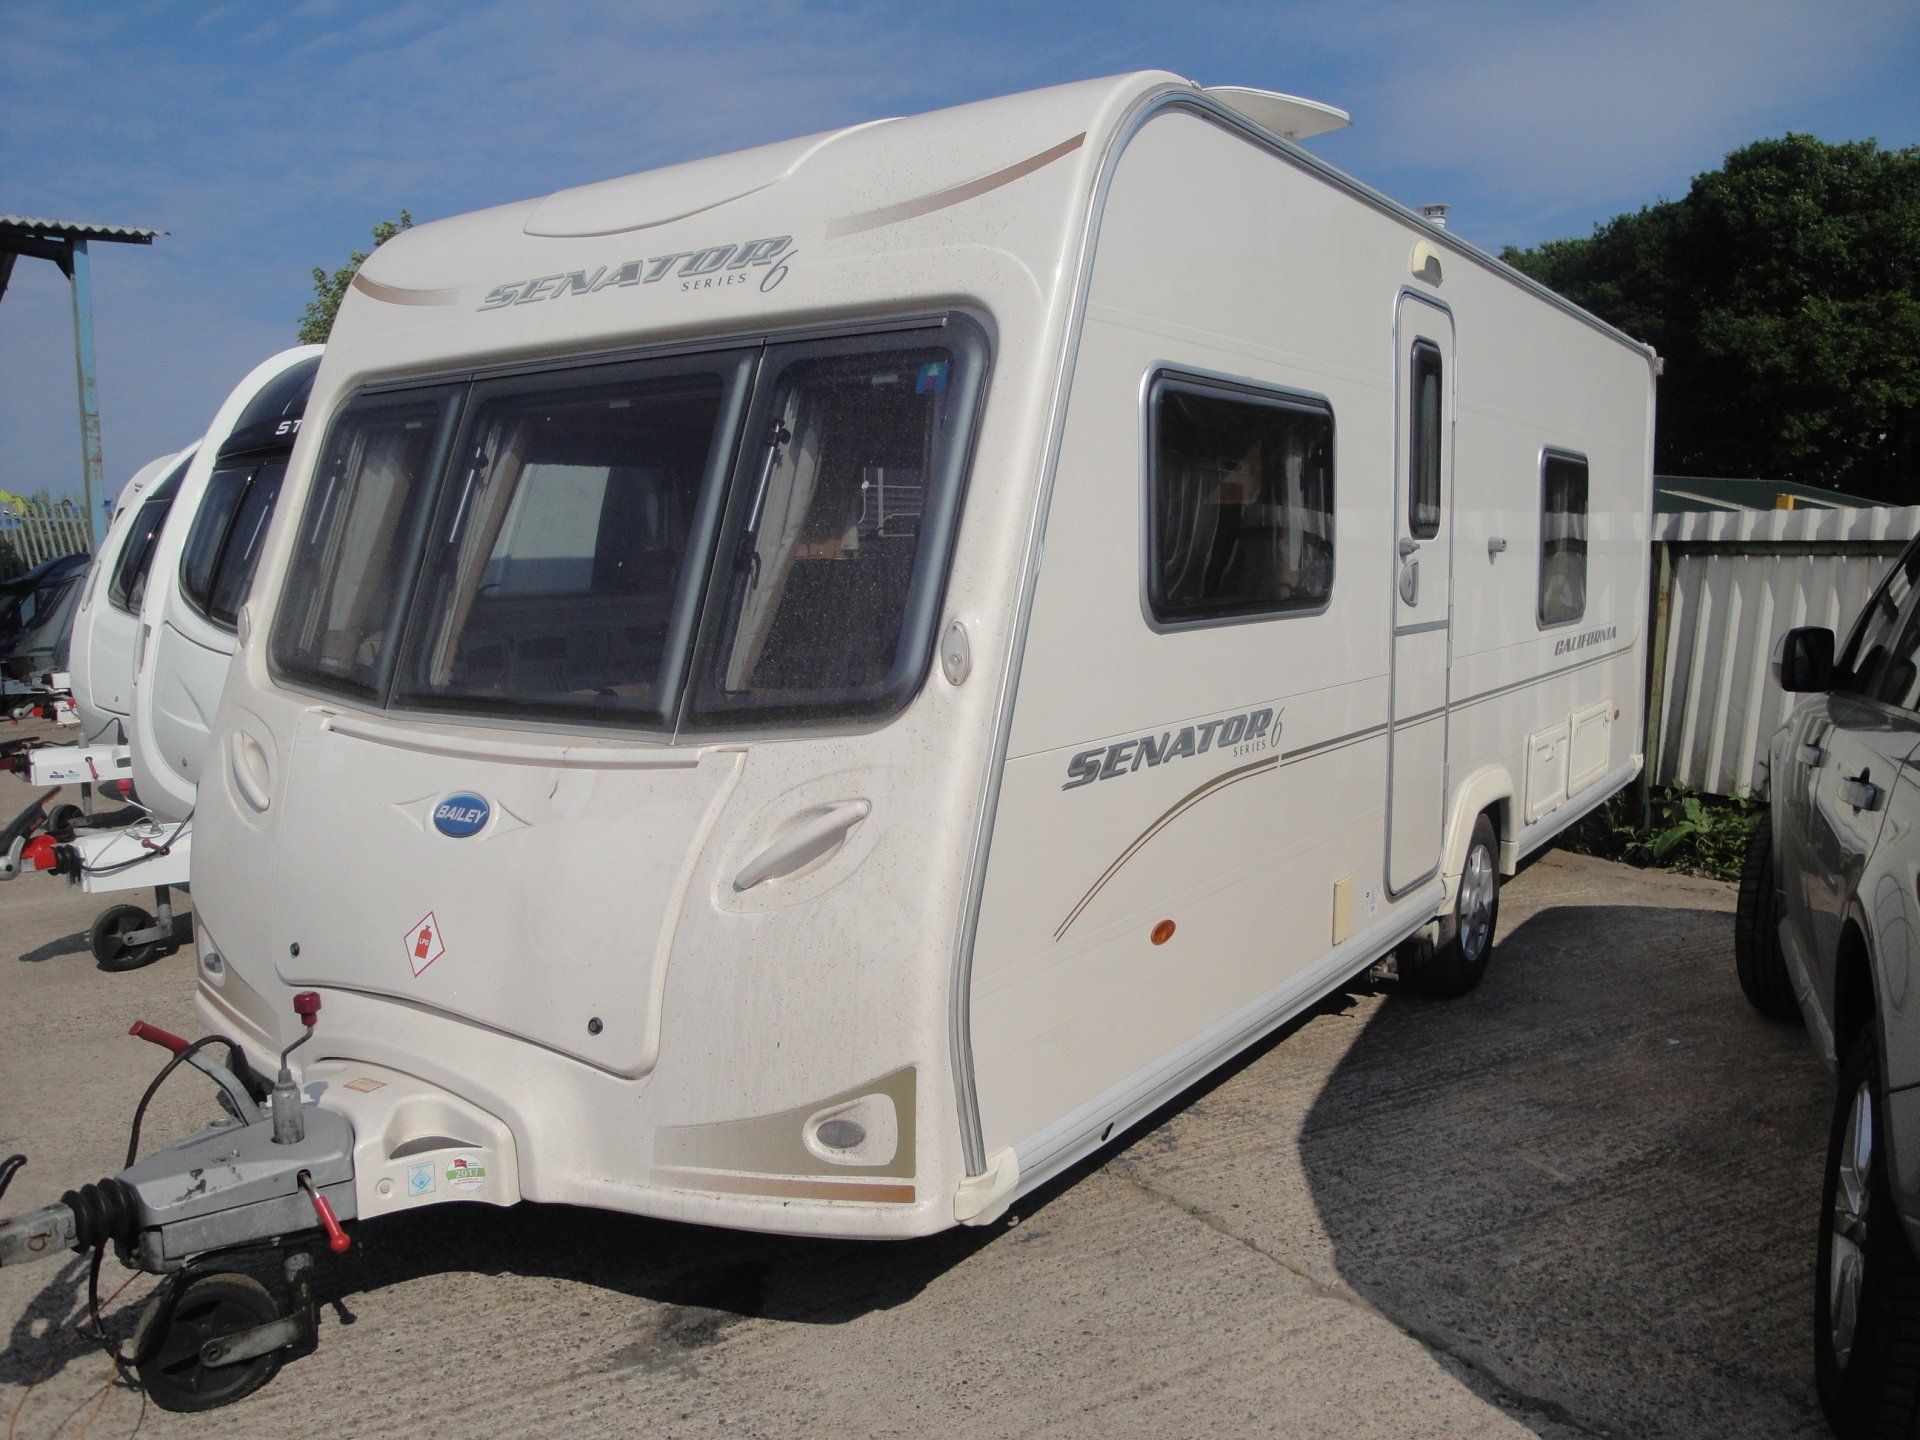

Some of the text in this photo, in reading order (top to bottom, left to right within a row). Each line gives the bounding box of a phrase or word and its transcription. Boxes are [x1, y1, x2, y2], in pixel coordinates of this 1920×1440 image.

[476, 235, 793, 313] SENATOR
[681, 249, 799, 293] SERIES 6
[1553, 626, 1617, 656] CALIFORNIA
[1061, 707, 1274, 791] SENATOR
[1233, 706, 1286, 757] SERIES 6
[436, 804, 487, 824] BAILEY
[456, 1168, 480, 1178] 2017
